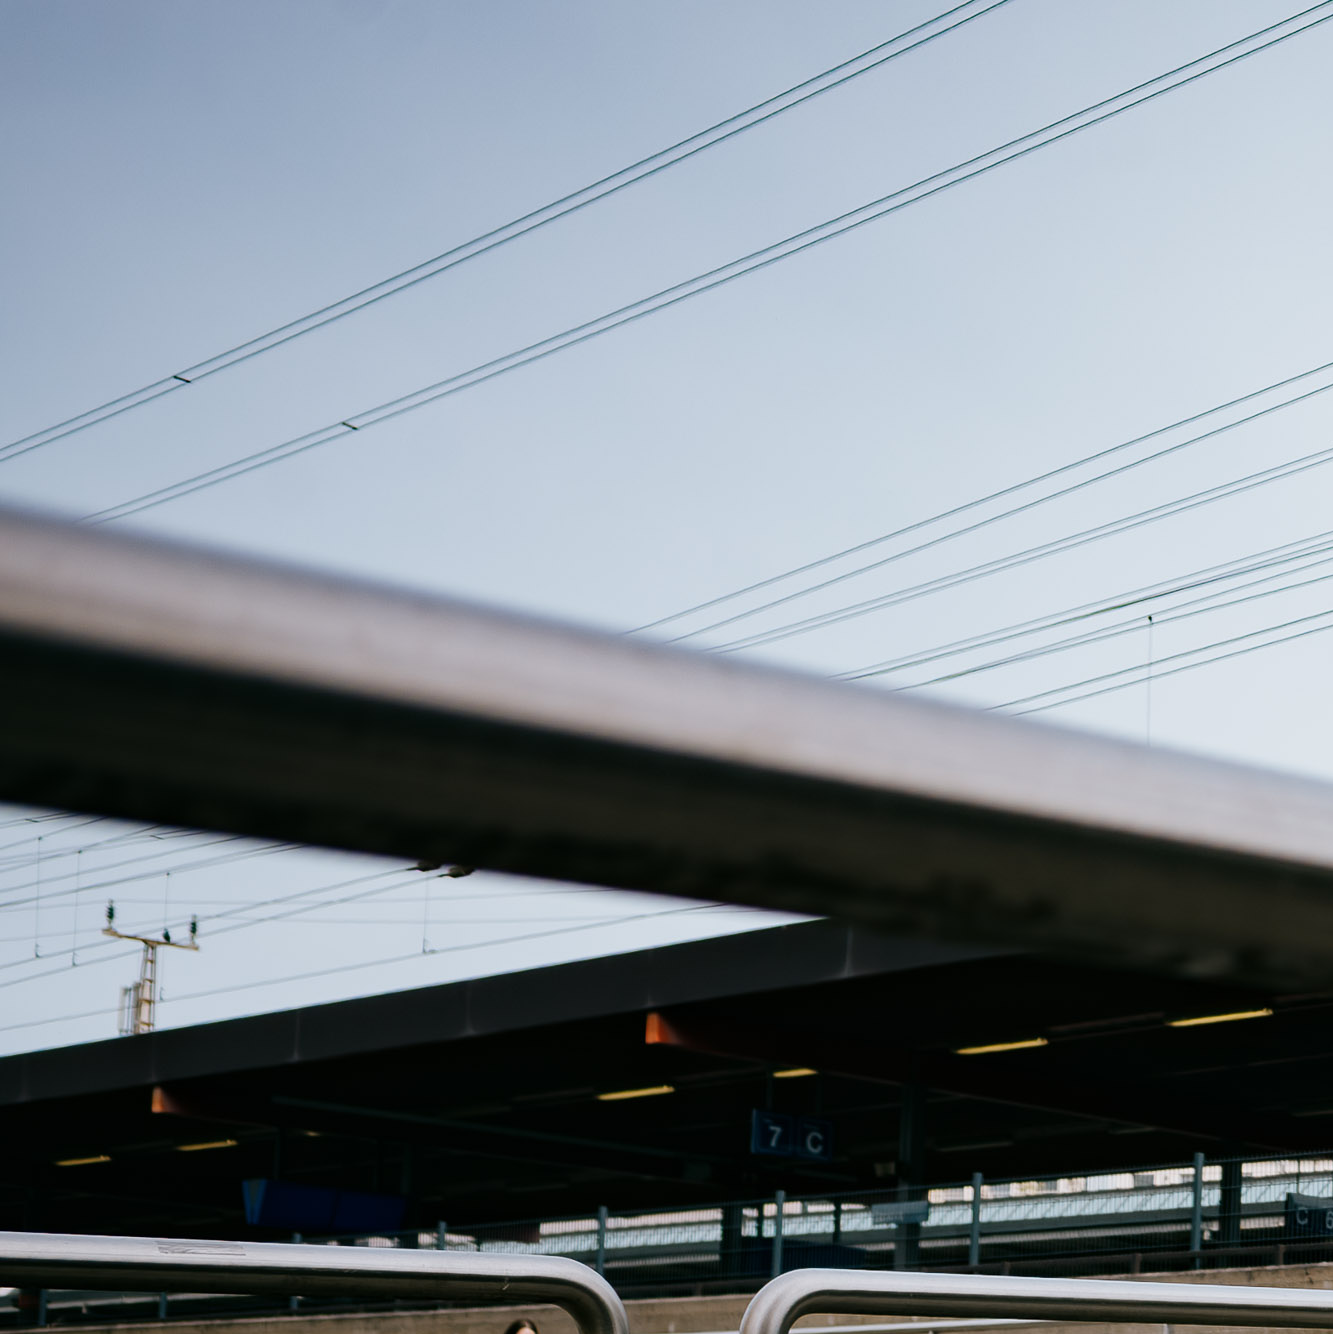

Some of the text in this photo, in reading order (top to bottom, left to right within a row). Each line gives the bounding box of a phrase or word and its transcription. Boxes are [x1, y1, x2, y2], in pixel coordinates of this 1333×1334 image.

[769, 1126, 824, 1153] 7 C
[1296, 1207, 1309, 1225] C
